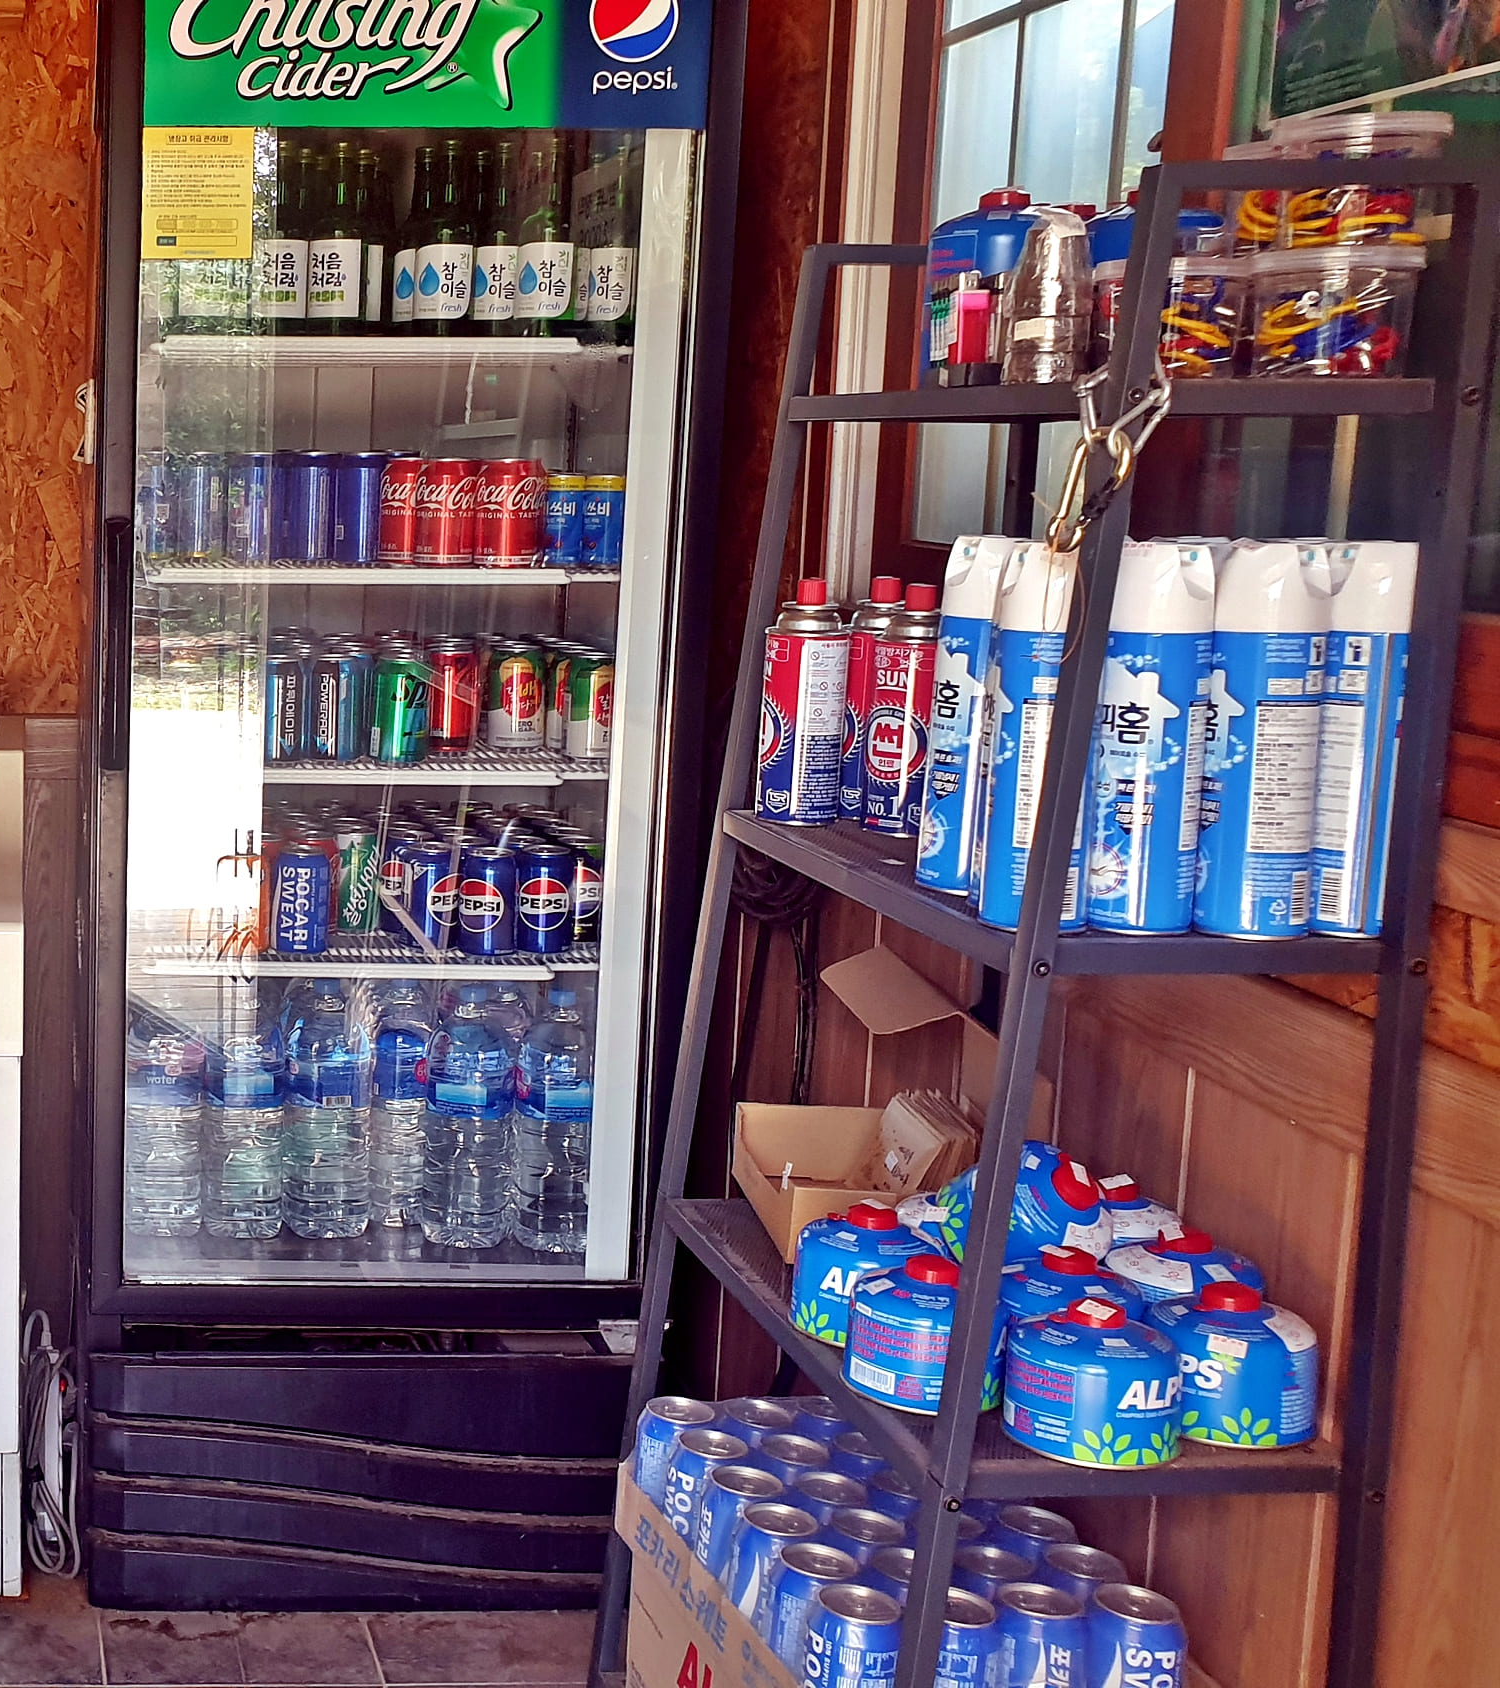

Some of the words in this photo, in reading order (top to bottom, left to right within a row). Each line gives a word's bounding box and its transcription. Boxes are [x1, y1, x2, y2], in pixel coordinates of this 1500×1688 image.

[592, 66, 673, 95] pepsi
[263, 252, 296, 270] 처음
[312, 252, 343, 271] 처음
[263, 272, 296, 287] 처럼
[311, 272, 342, 287] 처럼
[549, 501, 576, 516] 쓰비
[585, 501, 610, 516] 쓰비
[319, 674, 330, 744] POWERADE
[280, 866, 296, 942] SWEAT
[293, 867, 311, 950] POCARI
[430, 895, 460, 907] PEP
[460, 899, 501, 912] PEPSI
[520, 897, 567, 909] PEPSI
[1181, 1353, 1224, 1390] PS
[1117, 1376, 1180, 1411] ALP
[672, 1471, 695, 1536] POC
